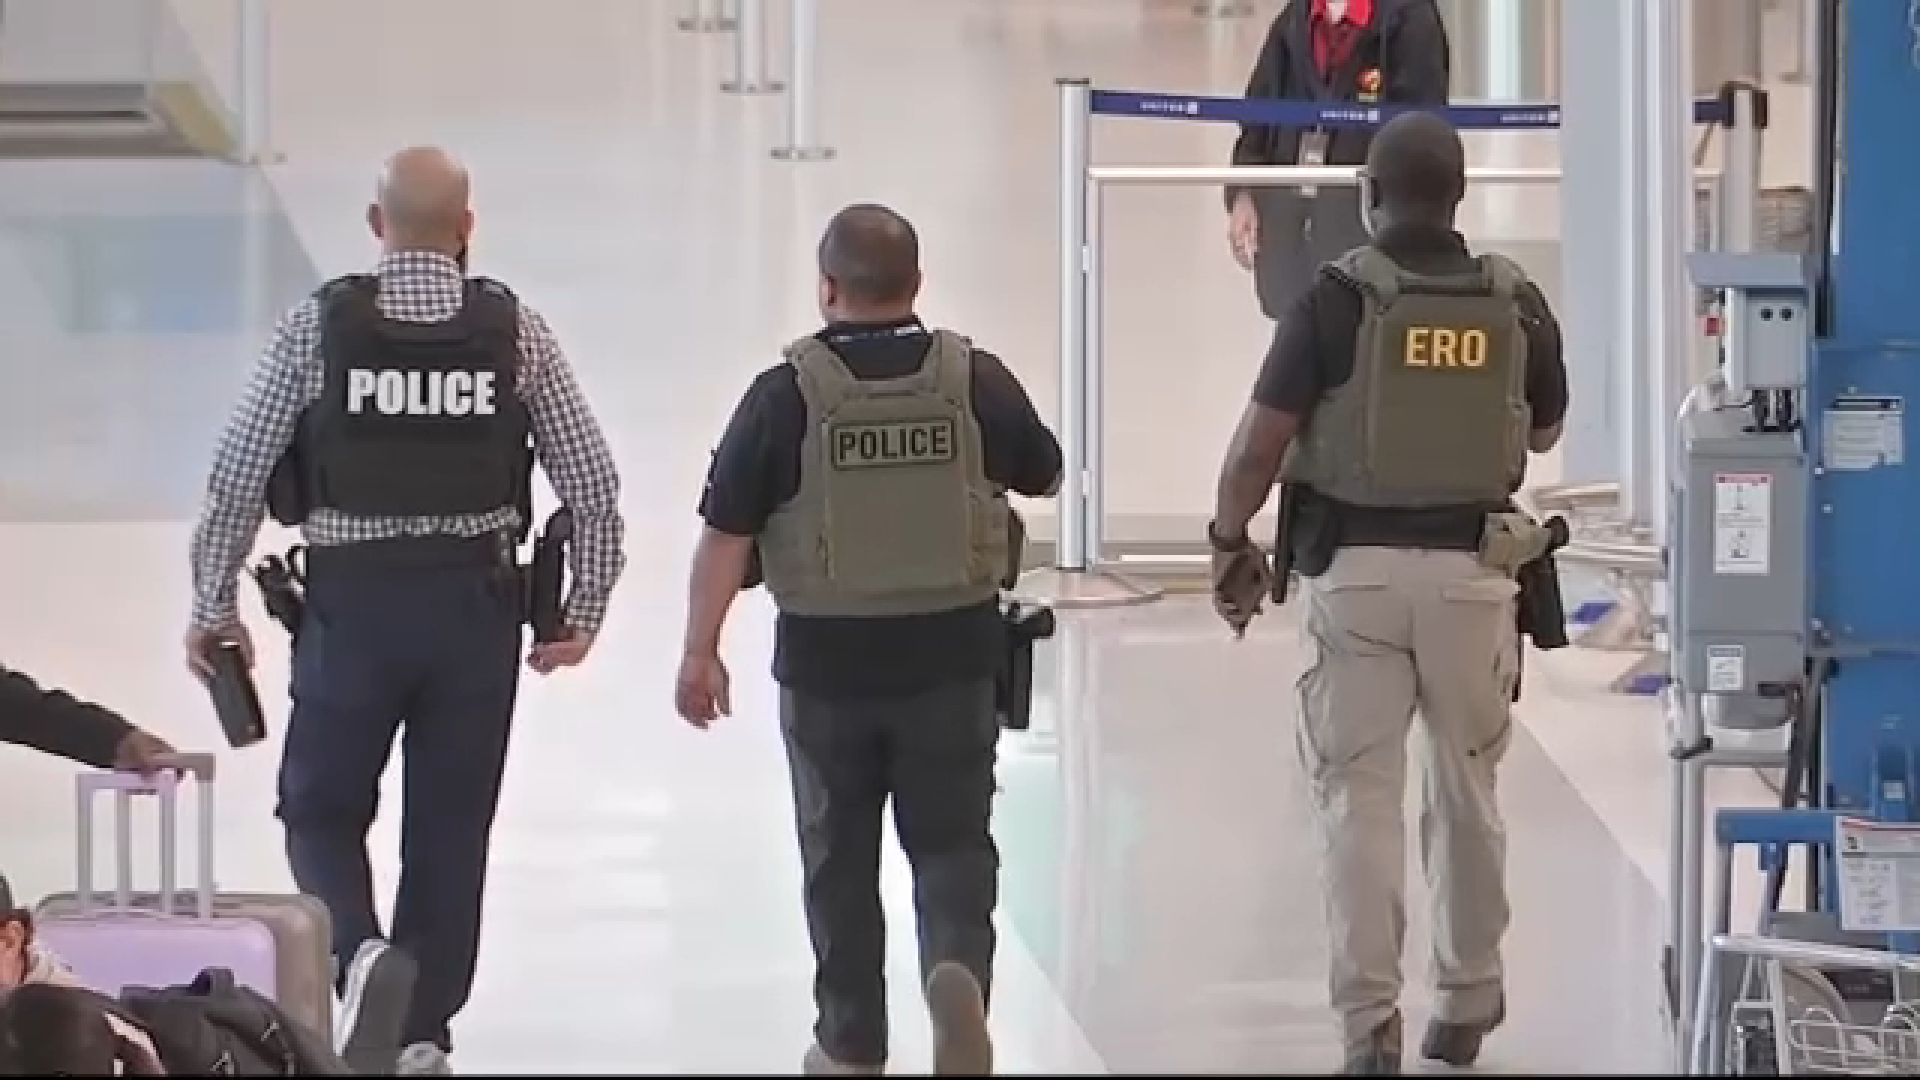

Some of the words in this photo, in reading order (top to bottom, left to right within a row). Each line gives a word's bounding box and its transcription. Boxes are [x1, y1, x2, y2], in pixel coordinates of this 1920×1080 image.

[1405, 326, 1487, 367] ERO
[347, 368, 496, 416] POLICE
[839, 425, 949, 463] POLICE
